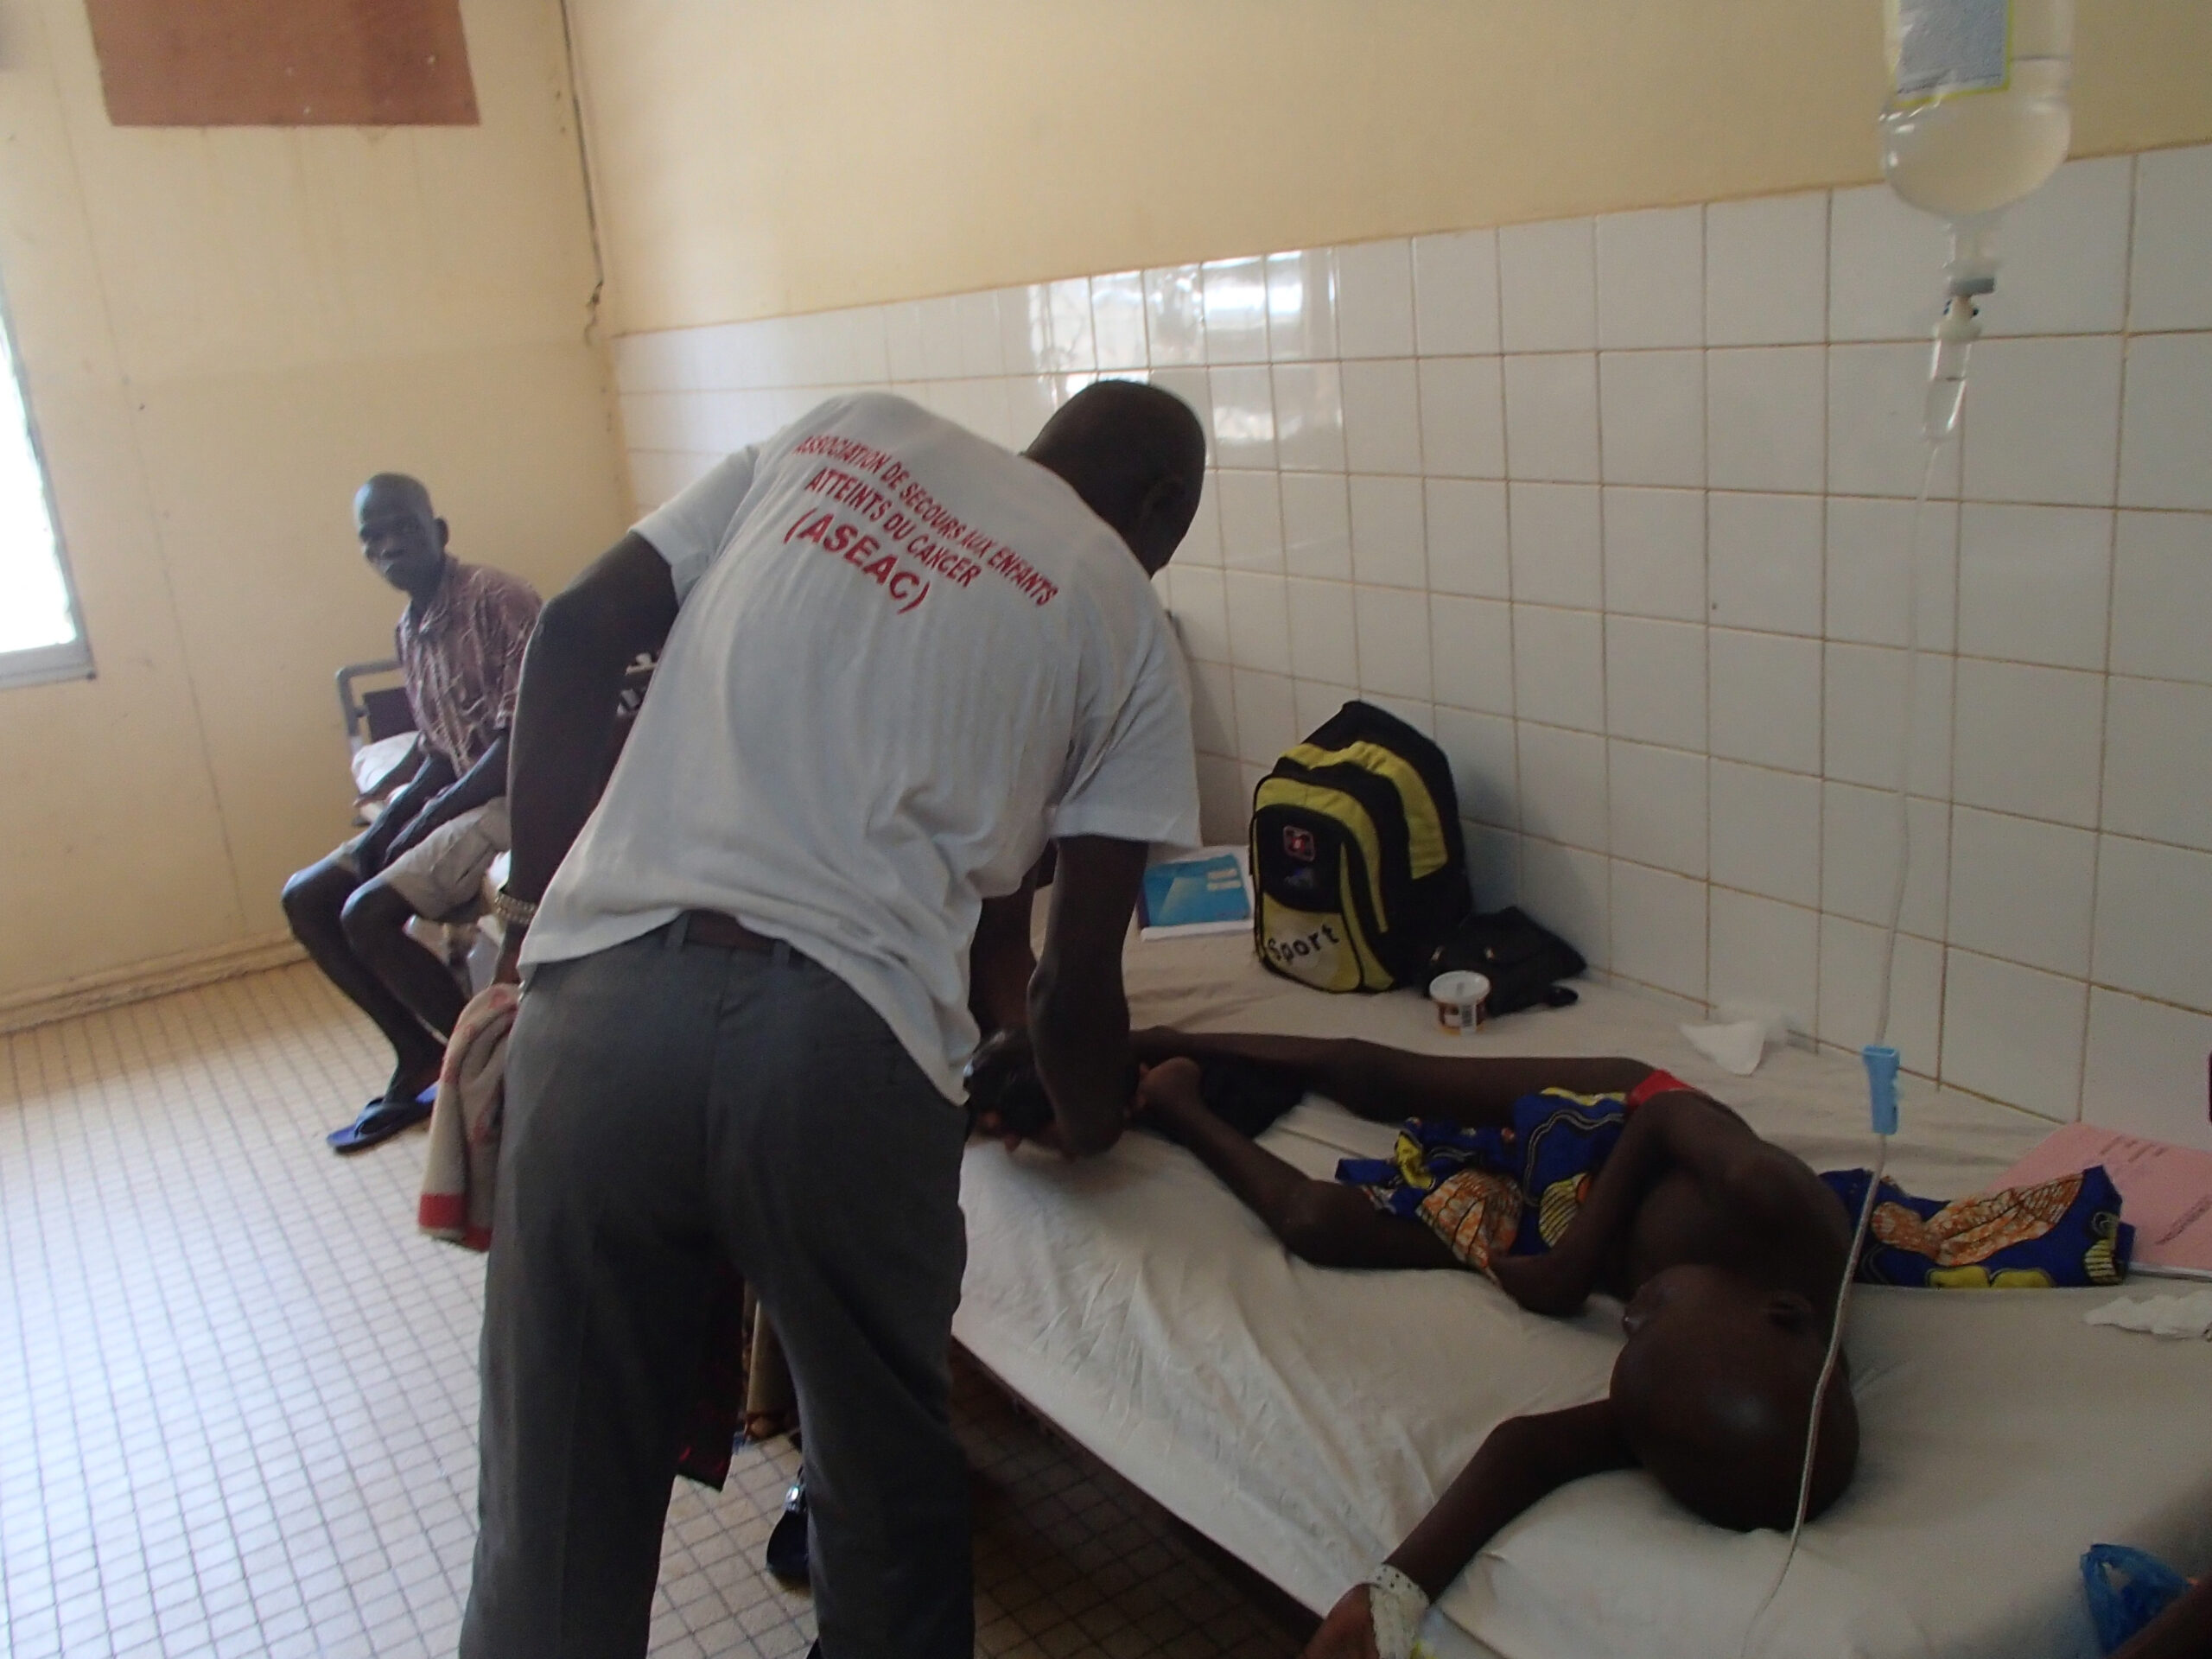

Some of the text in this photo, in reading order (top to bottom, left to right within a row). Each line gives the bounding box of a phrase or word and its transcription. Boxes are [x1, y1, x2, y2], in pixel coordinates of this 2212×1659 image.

[783, 507, 931, 614] (ASEAC)
[804, 467, 982, 588] ATTEINTS DU CANCER
[880, 461, 910, 490] DE
[899, 482, 967, 540] SECOURS
[960, 530, 995, 558] AUX
[988, 546, 1059, 607] ENFANTS
[1268, 925, 1339, 963] Sport
